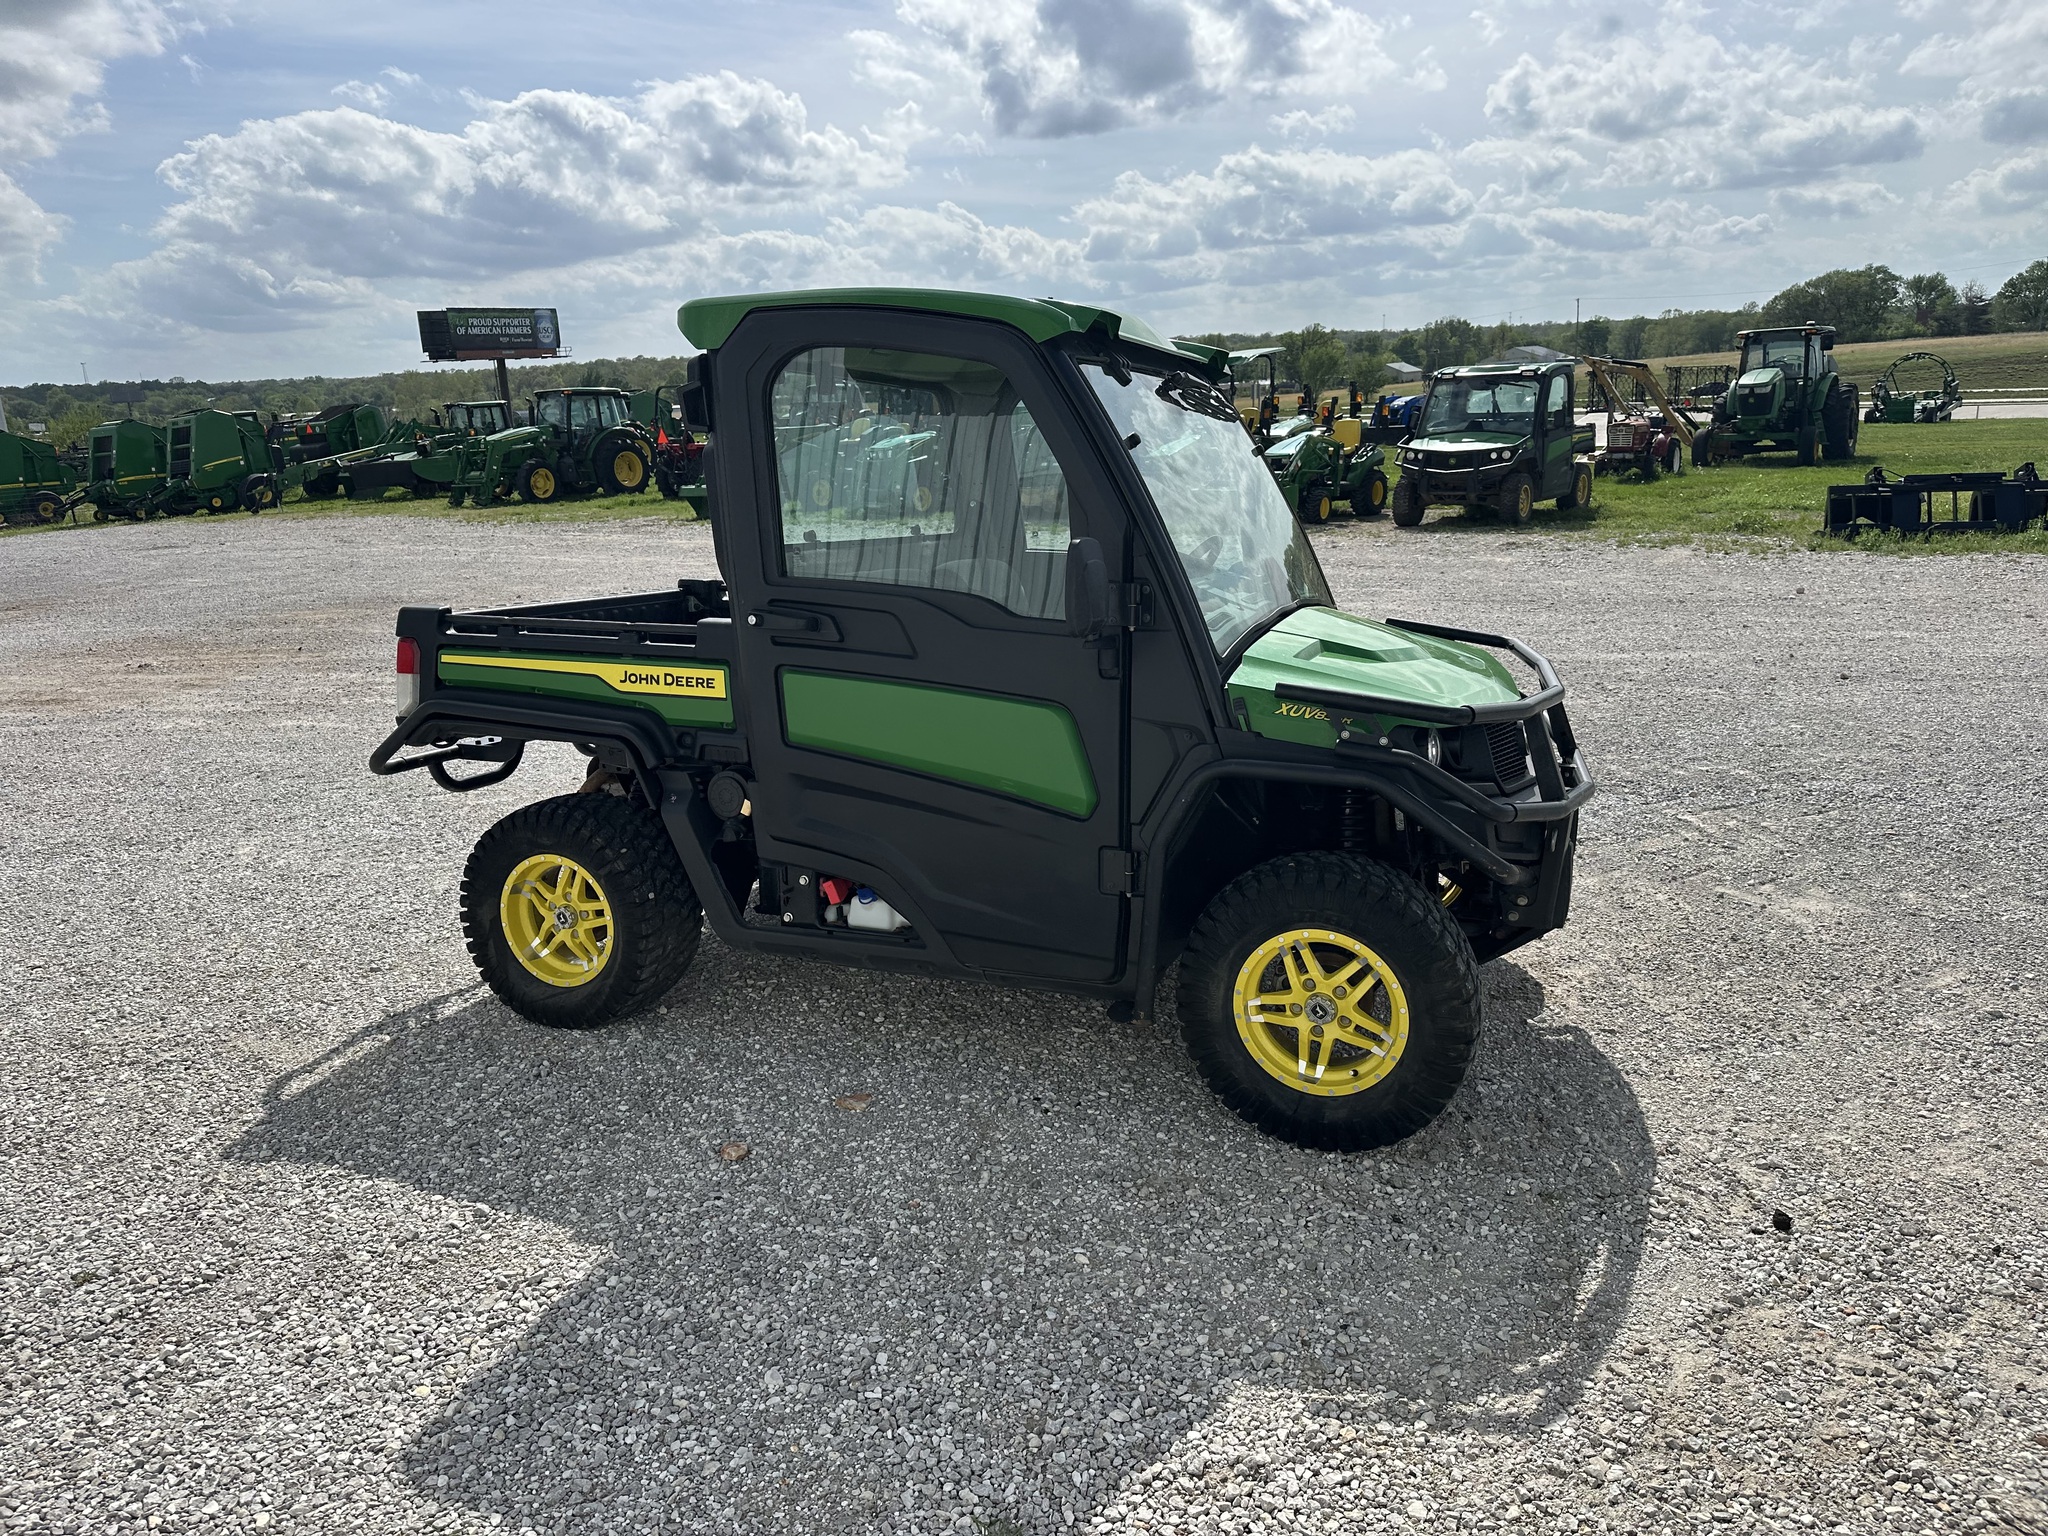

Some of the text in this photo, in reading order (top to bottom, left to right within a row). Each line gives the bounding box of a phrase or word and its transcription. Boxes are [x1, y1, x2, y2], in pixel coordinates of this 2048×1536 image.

[468, 318, 531, 326] PROUD SUPPORTER
[456, 326, 532, 335] OF AMERICAN FARMERS
[620, 670, 715, 689] JOHN DEERE
